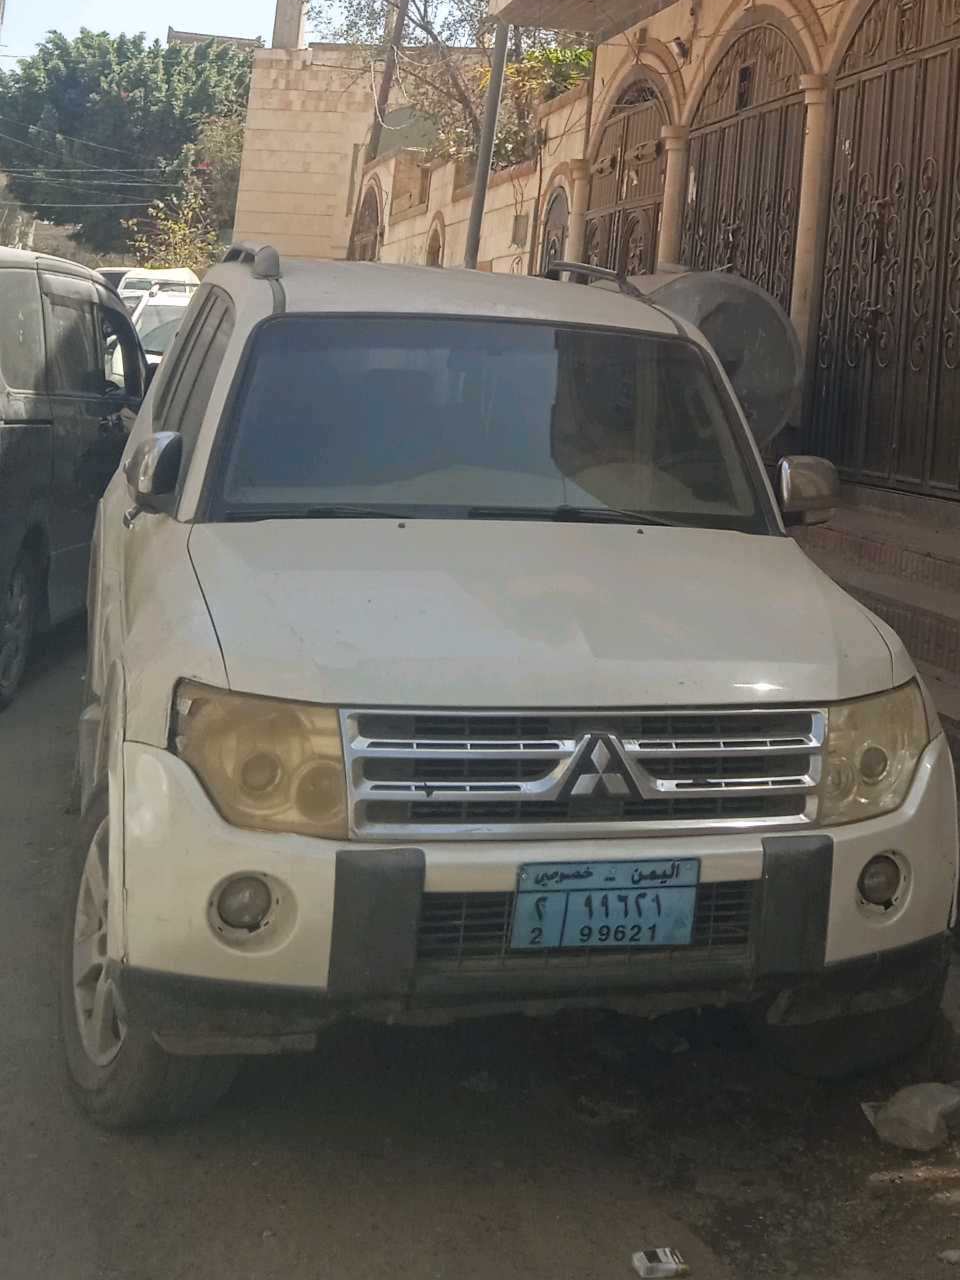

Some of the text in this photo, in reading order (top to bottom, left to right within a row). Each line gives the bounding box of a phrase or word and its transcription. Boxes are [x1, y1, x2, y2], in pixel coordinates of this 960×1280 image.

[533, 866, 594, 887] خصوصي
[630, 862, 681, 885] اليمن
[534, 892, 662, 920] ٢ ٩٩٦٢١
[528, 923, 658, 945] 2 99621
